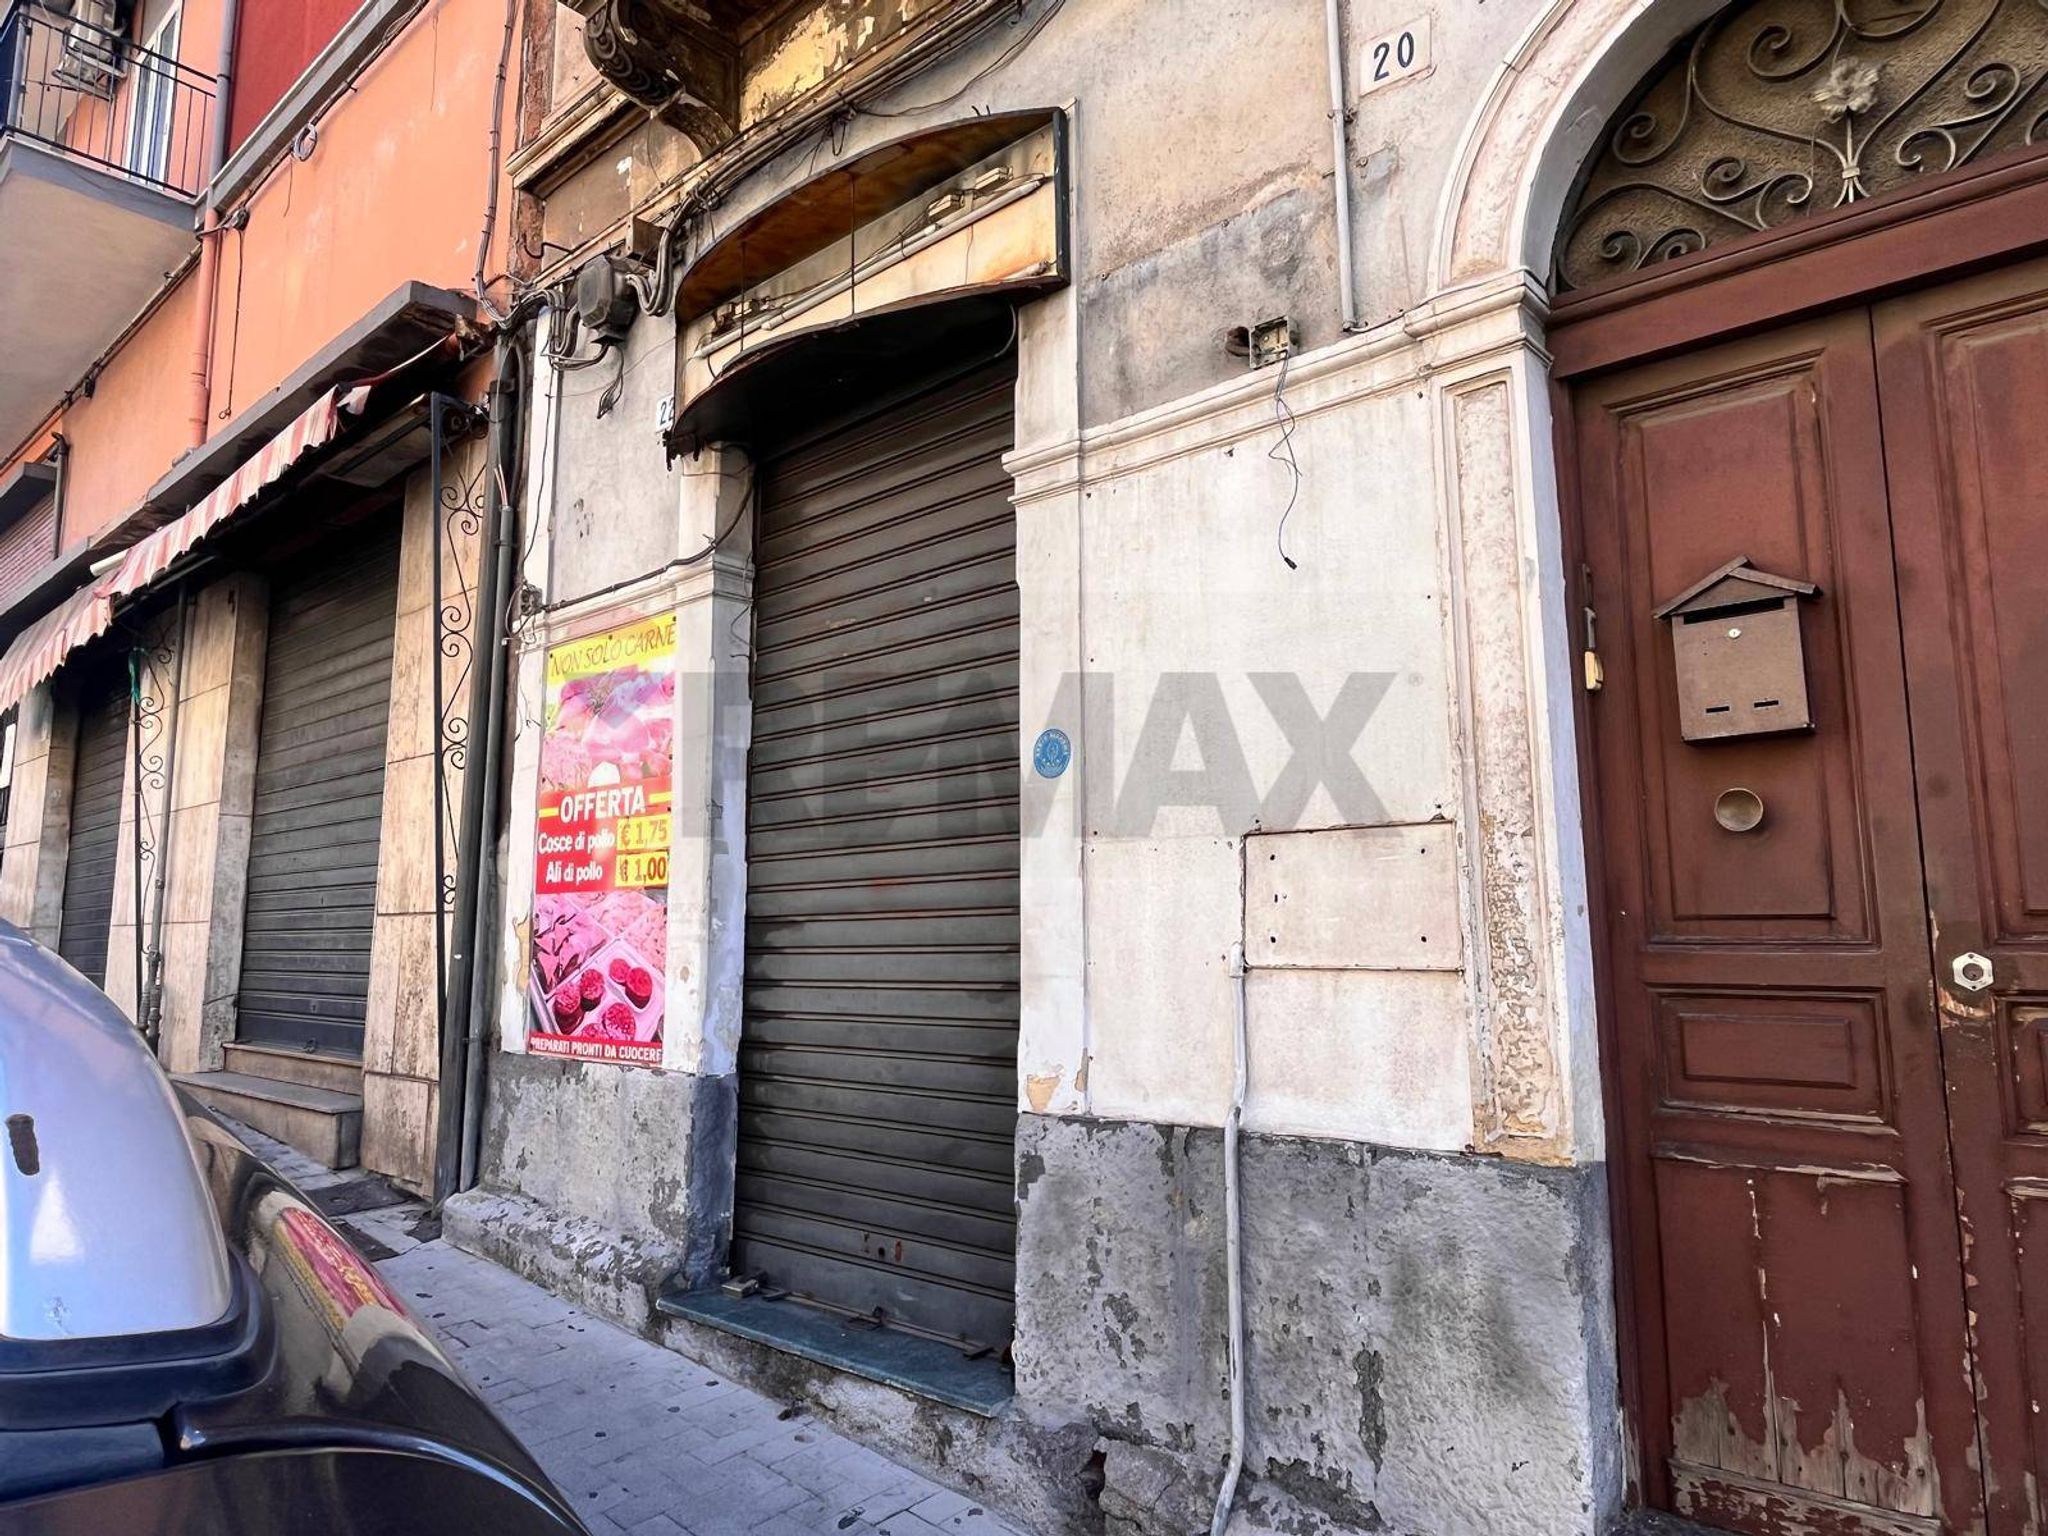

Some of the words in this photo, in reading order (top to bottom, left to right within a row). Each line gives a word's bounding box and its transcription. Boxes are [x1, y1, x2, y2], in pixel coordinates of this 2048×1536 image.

[1373, 31, 1415, 82] 20
[551, 650, 583, 677] NON
[585, 638, 622, 669] SOLO
[624, 623, 677, 656] CARNE
[560, 785, 647, 824] OFFERTA
[538, 832, 573, 854] Cosce
[574, 831, 586, 850] di
[587, 828, 616, 854] pollo
[635, 818, 668, 845] 1,75
[546, 860, 562, 884] Ali
[563, 862, 575, 882] di
[576, 860, 603, 885] pollo
[635, 856, 667, 883] 1,00
[530, 1036, 570, 1054] PREPARATI
[571, 1041, 603, 1057] PRONTI
[604, 1044, 617, 1058] DA
